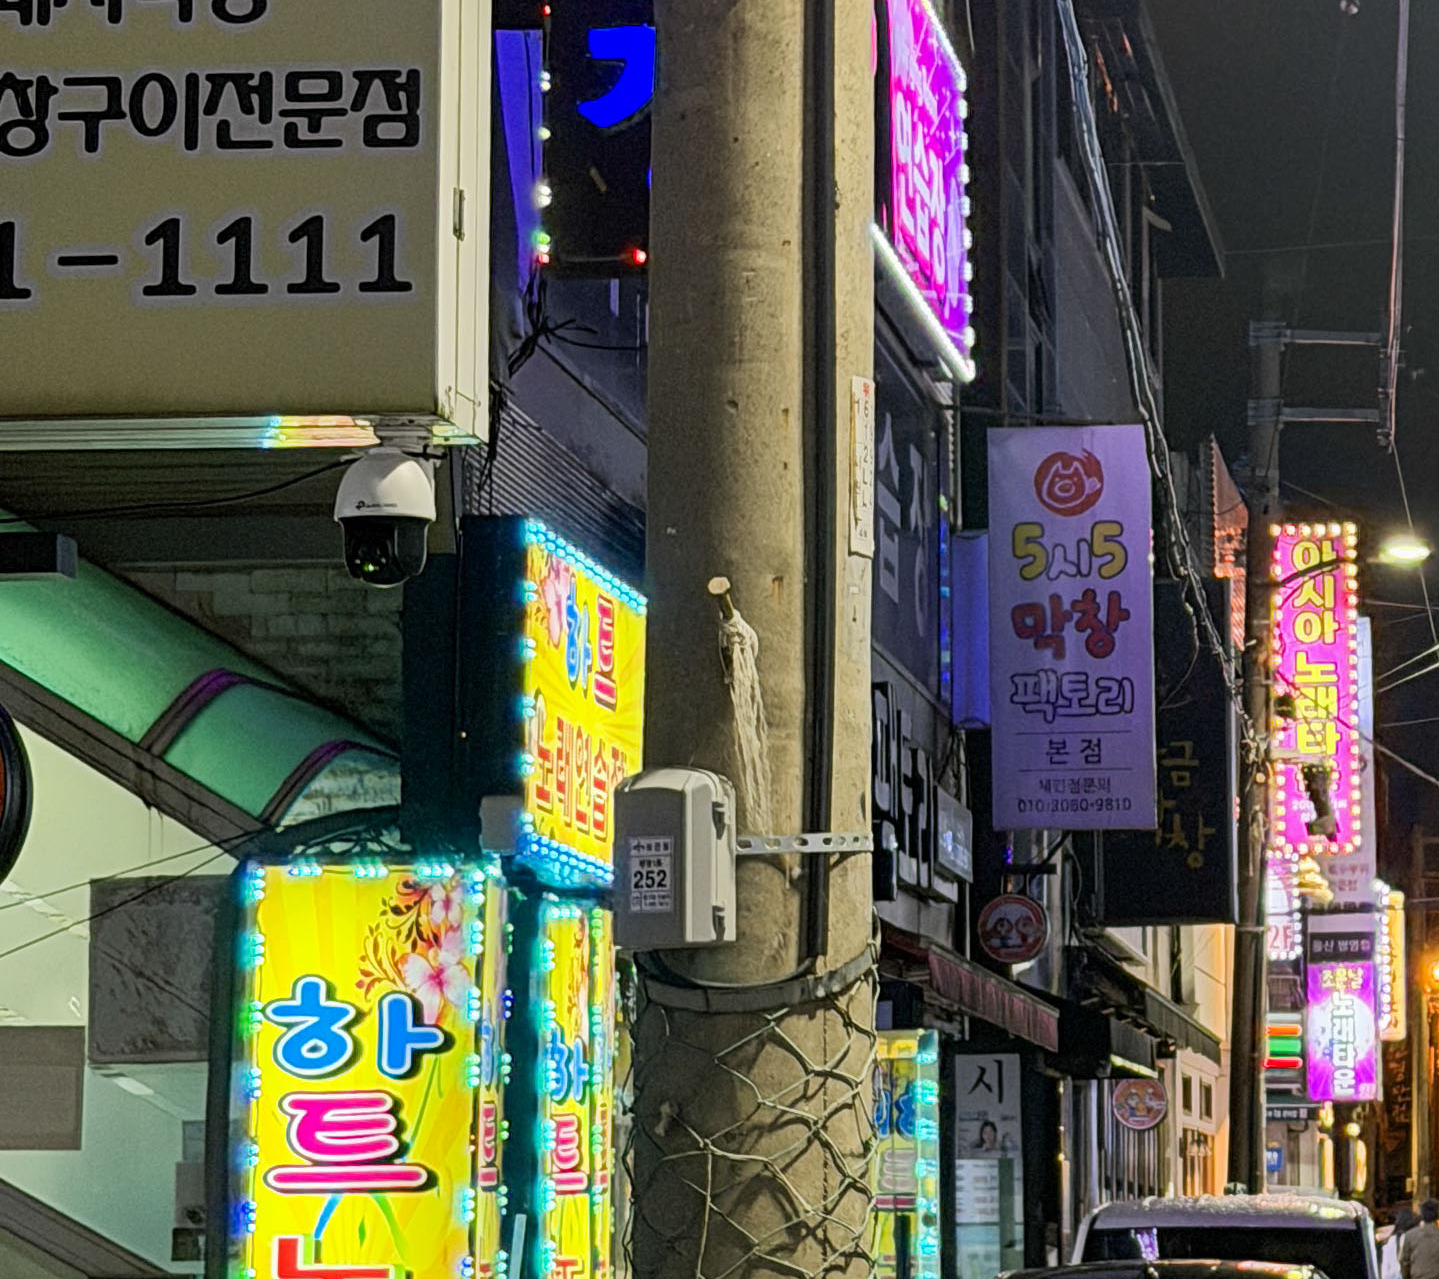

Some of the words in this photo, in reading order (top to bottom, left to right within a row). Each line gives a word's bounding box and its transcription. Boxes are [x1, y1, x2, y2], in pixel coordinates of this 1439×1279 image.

[1011, 520, 1129, 582] 5시5
[1010, 587, 1132, 661] 막창
[1291, 539, 1340, 646] 아시아
[1009, 668, 1136, 724] 팩토리
[1293, 650, 1342, 757] 노래타
[633, 869, 668, 890] 252
[264, 975, 452, 1194] 하트
